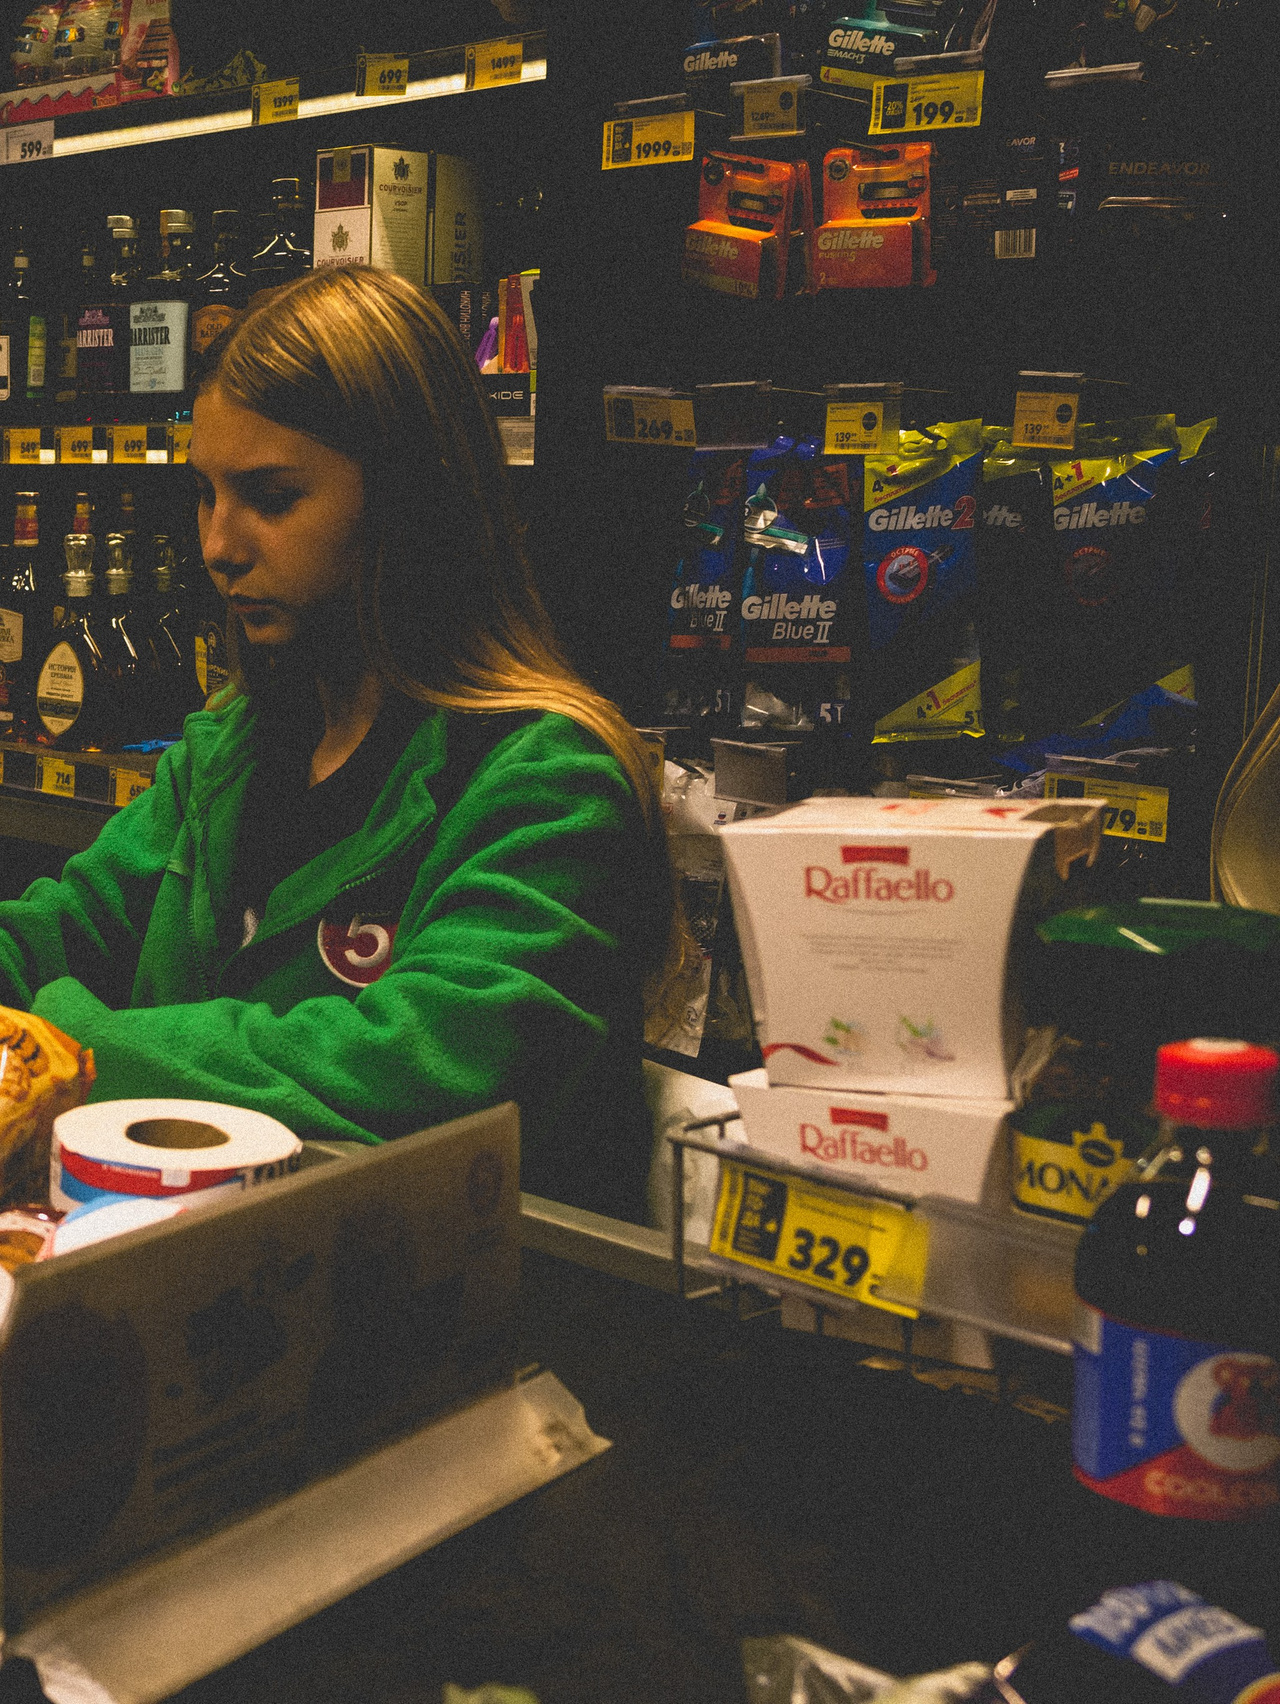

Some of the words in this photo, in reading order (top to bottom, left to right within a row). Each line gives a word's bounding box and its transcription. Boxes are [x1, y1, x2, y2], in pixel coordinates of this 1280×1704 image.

[828, 29, 896, 56] Gillette
[684, 51, 739, 73] Gillette
[379, 69, 402, 84] 699
[272, 97, 293, 108] 1399
[912, 100, 954, 126] 199
[20, 140, 43, 160] 599
[635, 140, 673, 160] 1999
[379, 184, 423, 195] COURVOISIER
[686, 231, 739, 260] Gillette
[818, 231, 885, 251] Gillette
[77, 329, 114, 347] ARRISTER
[637, 417, 674, 440] 269
[835, 431, 851, 443] 139
[1024, 422, 1042, 434] 139
[868, 504, 954, 532] Gillette
[951, 495, 977, 530] 2
[1053, 502, 1147, 531] Gillette
[670, 584, 732, 610] Gillette
[741, 593, 837, 621] Gillette
[772, 621, 814, 641] Blue
[56, 771, 70, 785] 714
[1103, 807, 1137, 833] 79
[804, 865, 956, 904] Raffaello
[344, 913, 390, 968] 5
[798, 1123, 929, 1172] Raffaello
[787, 1228, 870, 1287] 329
